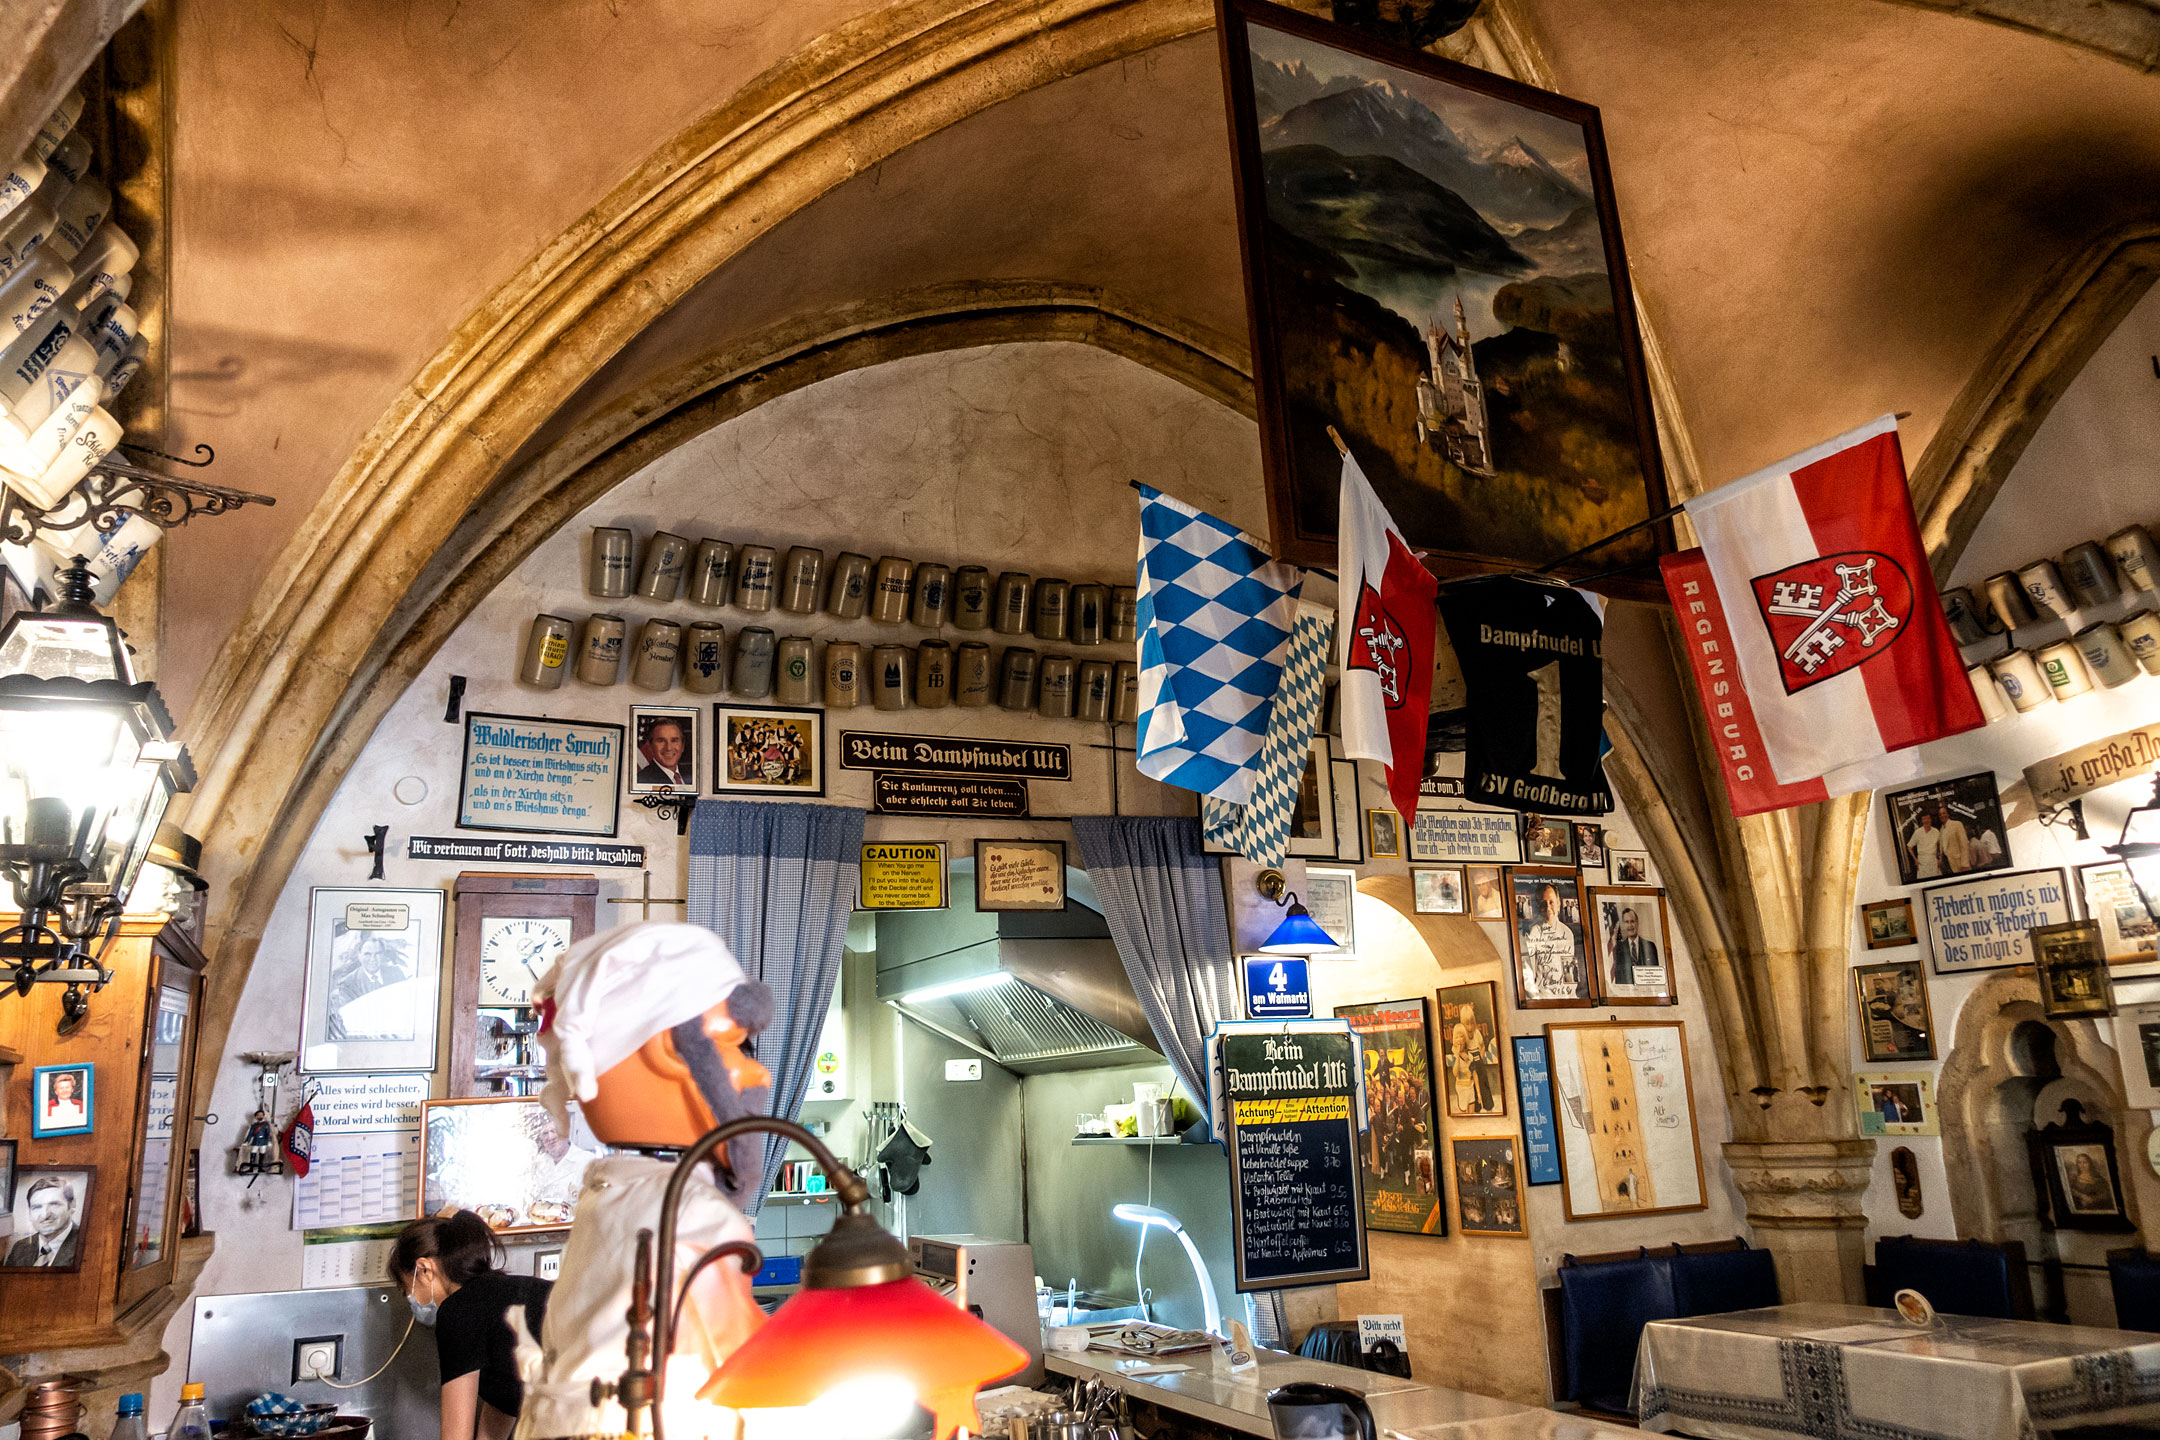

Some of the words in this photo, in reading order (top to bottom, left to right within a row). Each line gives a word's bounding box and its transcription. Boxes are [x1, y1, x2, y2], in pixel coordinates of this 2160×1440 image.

[1480, 624, 1583, 656] Dampfnudel
[928, 673, 944, 689] HB
[1682, 579, 1755, 783] REGENSBURG
[1527, 660, 1566, 780] 1
[473, 725, 563, 754] Waldlerischer
[565, 733, 611, 760] Spruch
[851, 739, 908, 761] Beim
[913, 742, 1027, 770] Dampfnudel
[1031, 749, 1062, 771] Uli
[489, 754, 501, 766] ist
[532, 757, 543, 769] im
[544, 758, 585, 773] Wirtshaus
[474, 766, 492, 778] und
[494, 769, 505, 779] an
[491, 785, 500, 798] in
[502, 786, 518, 799] der
[518, 788, 548, 804] Kircha
[881, 780, 899, 791] Die
[901, 781, 957, 795] Konkurrenz
[960, 784, 977, 794] soll
[1436, 781, 1455, 795] vom
[1513, 779, 1588, 811] Großberg
[472, 799, 491, 811] und
[514, 800, 559, 814] Wirtshaus
[886, 794, 908, 804] aber
[910, 795, 948, 807] schlecht
[951, 797, 968, 807] soll
[971, 797, 988, 808] Sie
[991, 798, 1017, 809] leben.
[1427, 815, 1458, 830] Menschen
[1458, 816, 1472, 831] sind
[1416, 828, 1427, 842] alle
[1427, 828, 1457, 843] Menschen
[1457, 829, 1479, 844] denken
[1479, 833, 1488, 843] an
[412, 840, 432, 855] Wir
[434, 841, 483, 858] vertrauen
[484, 842, 502, 860] auf
[531, 844, 570, 863] deshalb
[571, 847, 594, 862] bitte
[866, 848, 936, 859] CAUTION
[1417, 843, 1429, 855] nur
[1429, 841, 1439, 855] ich
[1447, 841, 1457, 855] ich
[1457, 843, 1473, 856] denk
[1473, 845, 1482, 856] an
[888, 884, 908, 892] Deckel
[920, 877, 934, 885] Gully
[896, 899, 926, 907] Tageslicht!
[1987, 884, 2036, 912] mögn's
[2038, 881, 2061, 904] nix
[1940, 919, 1969, 941] aber
[1971, 915, 1993, 937] nix
[1992, 907, 2049, 938] Arbeit'n
[1943, 941, 1969, 963] des
[1268, 962, 1288, 992] 4
[1252, 994, 1266, 1005] am
[1267, 991, 1308, 1004] Watmarkt
[1262, 1036, 1304, 1064] Beim
[1228, 1062, 1320, 1096] Dampfnudel
[1322, 1055, 1348, 1094] Uli
[316, 1081, 342, 1096] Alles
[345, 1084, 366, 1094] wird
[313, 1102, 331, 1111] nur
[333, 1100, 358, 1111] eines
[361, 1099, 383, 1109] wird
[385, 1099, 418, 1110] besser,
[1238, 1106, 1277, 1119] Achtung
[1306, 1102, 1347, 1115] Attention
[322, 1116, 350, 1126] Moral
[352, 1114, 373, 1125] wird
[1240, 1128, 1302, 1145] Dampfnudeln
[1241, 1144, 1254, 1155] mit
[1255, 1143, 1281, 1154] Vanille
[1290, 1183, 1304, 1193] mit
[1304, 1182, 1326, 1195] Kraut
[1246, 1209, 1252, 1220] 4
[1297, 1206, 1310, 1218] mit
[1312, 1205, 1331, 1218] Kraut
[1246, 1224, 1253, 1235] 6
[1298, 1220, 1309, 1229] mit
[1292, 1248, 1328, 1262] Apfelmus
[1362, 1319, 1382, 1331] Bitte
[1383, 1319, 1402, 1331] nicht
